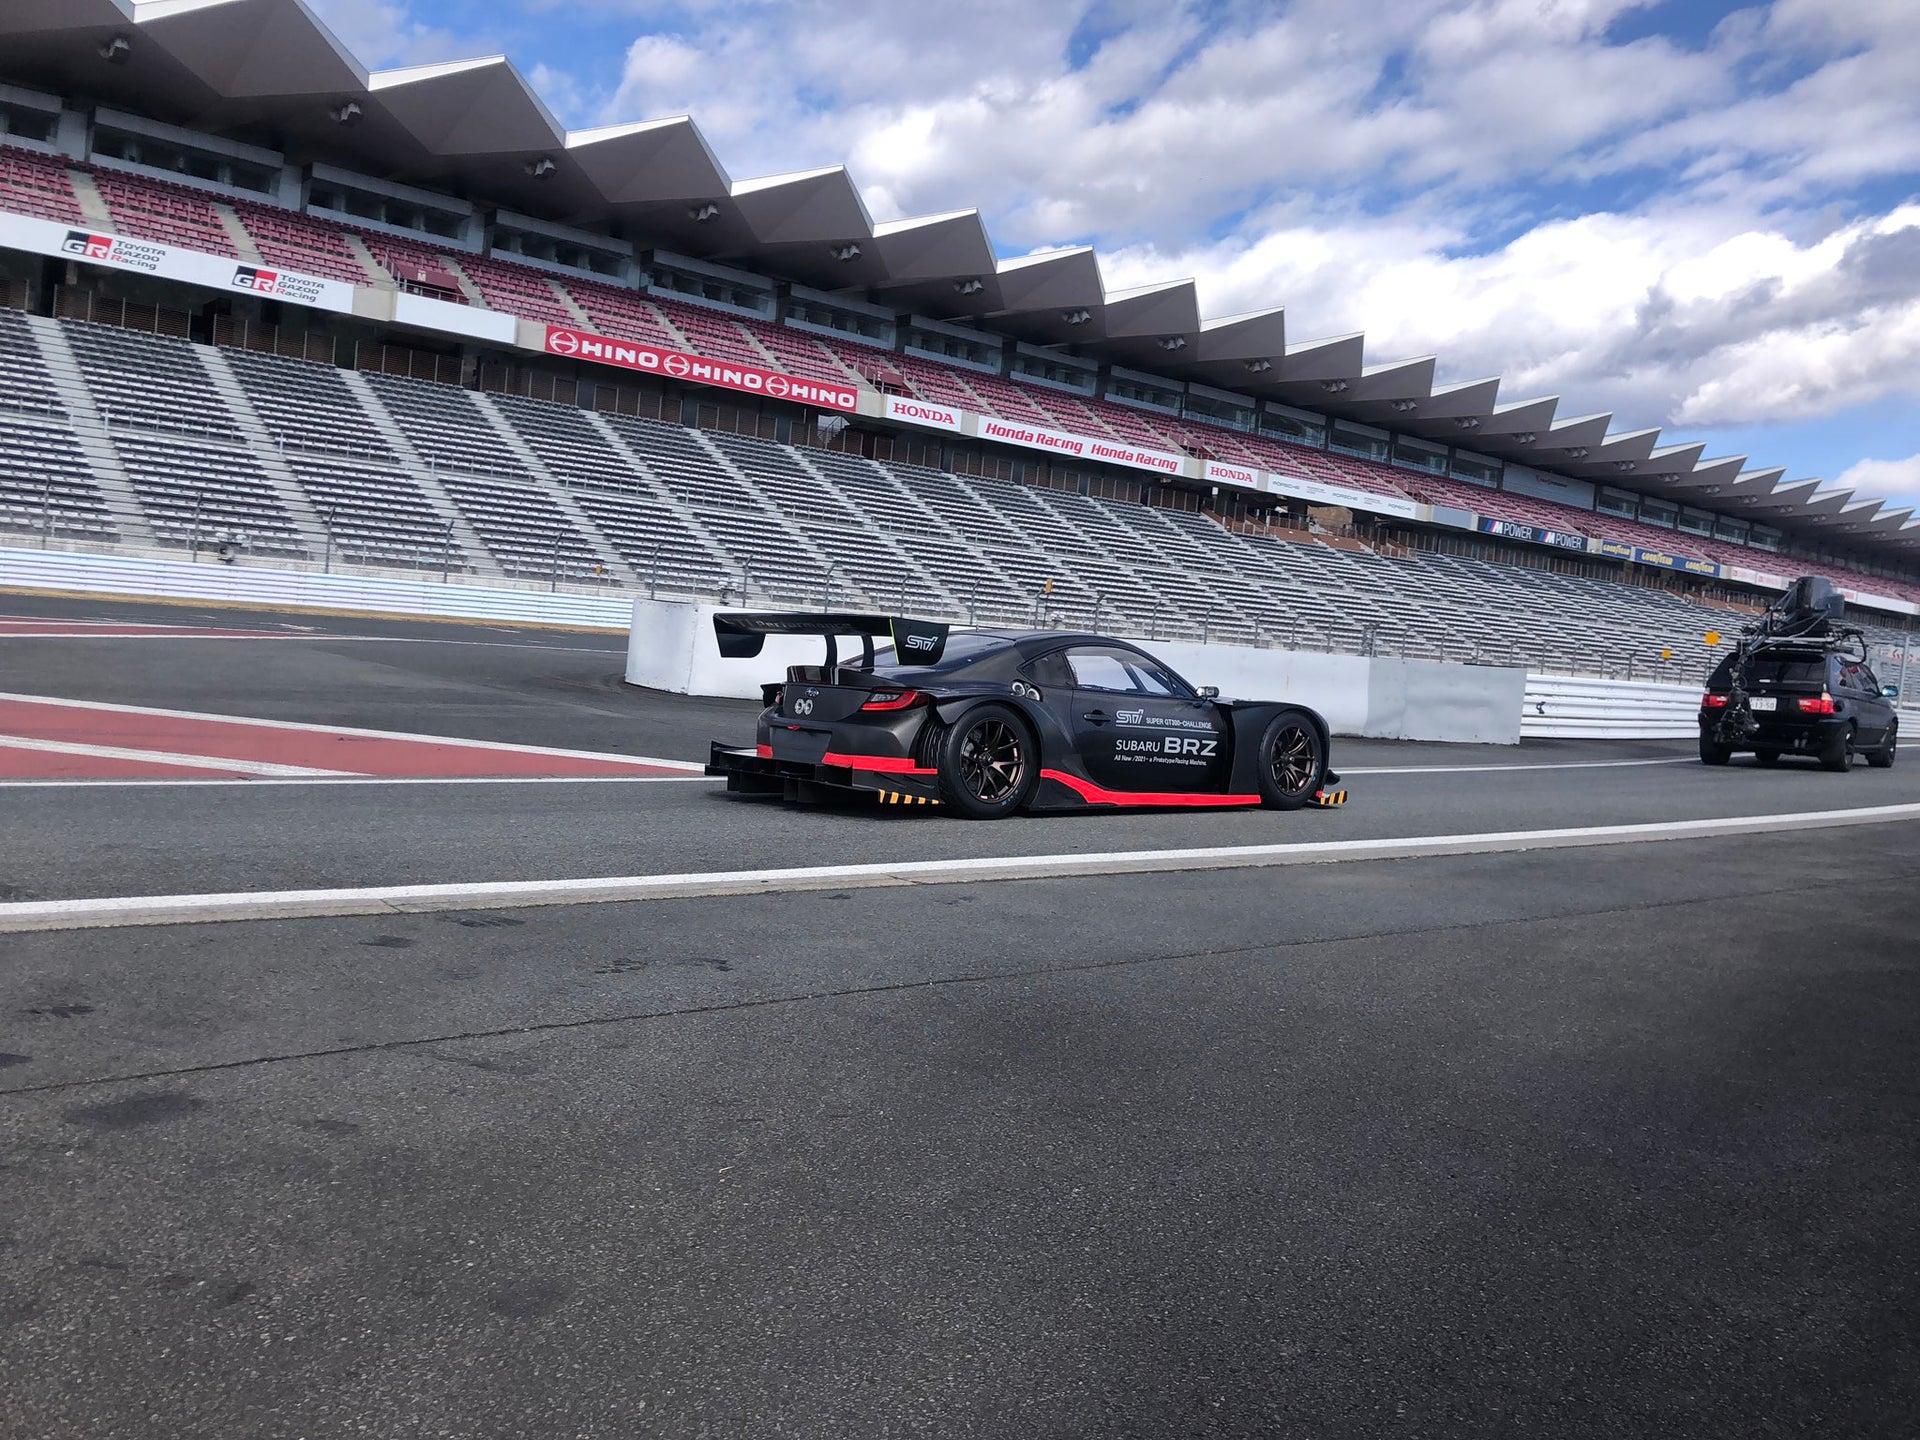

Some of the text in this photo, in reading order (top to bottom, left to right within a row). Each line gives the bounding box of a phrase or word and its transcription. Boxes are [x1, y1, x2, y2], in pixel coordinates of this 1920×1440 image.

[62, 233, 112, 259] GR
[112, 247, 160, 262] GAZOO
[116, 240, 166, 256] TOYOTA
[111, 254, 157, 271] Racing
[232, 268, 277, 293] GR
[278, 281, 320, 295] GAZOO
[280, 274, 325, 289] TOYOTA
[275, 287, 317, 303] Racing
[581, 340, 855, 408] HINO HINO HINO
[892, 402, 956, 425] HONDA
[985, 422, 1178, 473] Honda Racing Honda Racing
[1210, 466, 1254, 483] HONDA
[1503, 523, 1532, 540] POWER
[1555, 533, 1583, 550] POWER
[1603, 544, 1631, 555] GOODYEAR
[1641, 551, 1673, 566] GOODYEAR
[1685, 561, 1715, 573] GOODYEAR
[1146, 717, 1164, 725] SUPER
[1164, 718, 1212, 729] GT300-CHALLENGE
[1115, 736, 1218, 757] SUBARU BRZ
